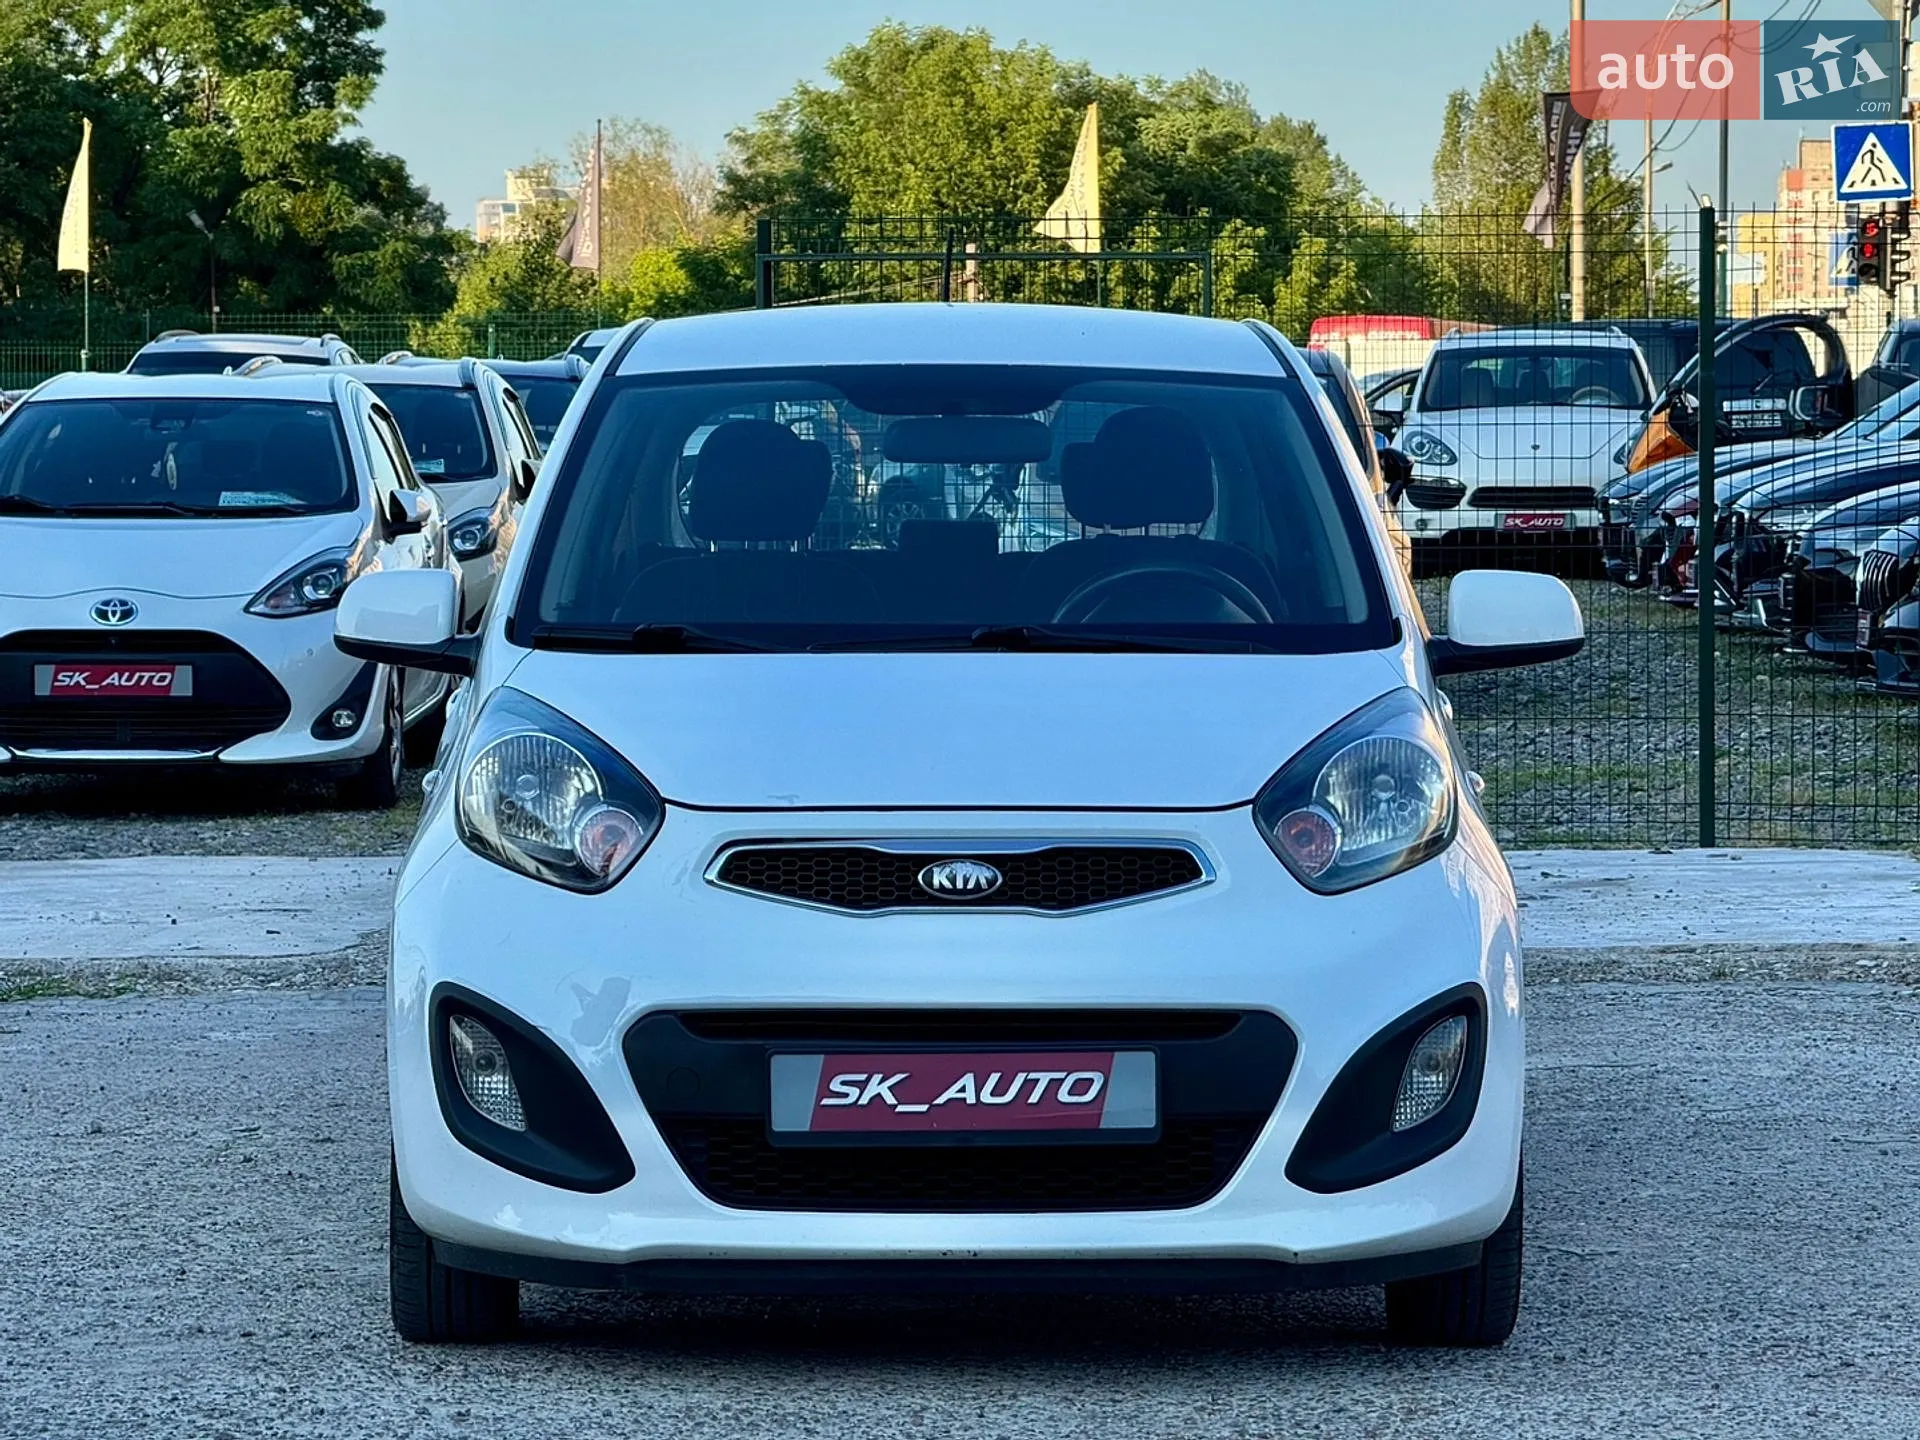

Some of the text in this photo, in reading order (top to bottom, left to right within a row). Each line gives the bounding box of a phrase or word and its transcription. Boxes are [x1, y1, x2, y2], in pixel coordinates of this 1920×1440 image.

[1504, 517, 1564, 528] SK_AUTO
[54, 671, 172, 689] SK_AUTO
[933, 862, 995, 889] KIA
[820, 1071, 1105, 1112] SK_AUTO
